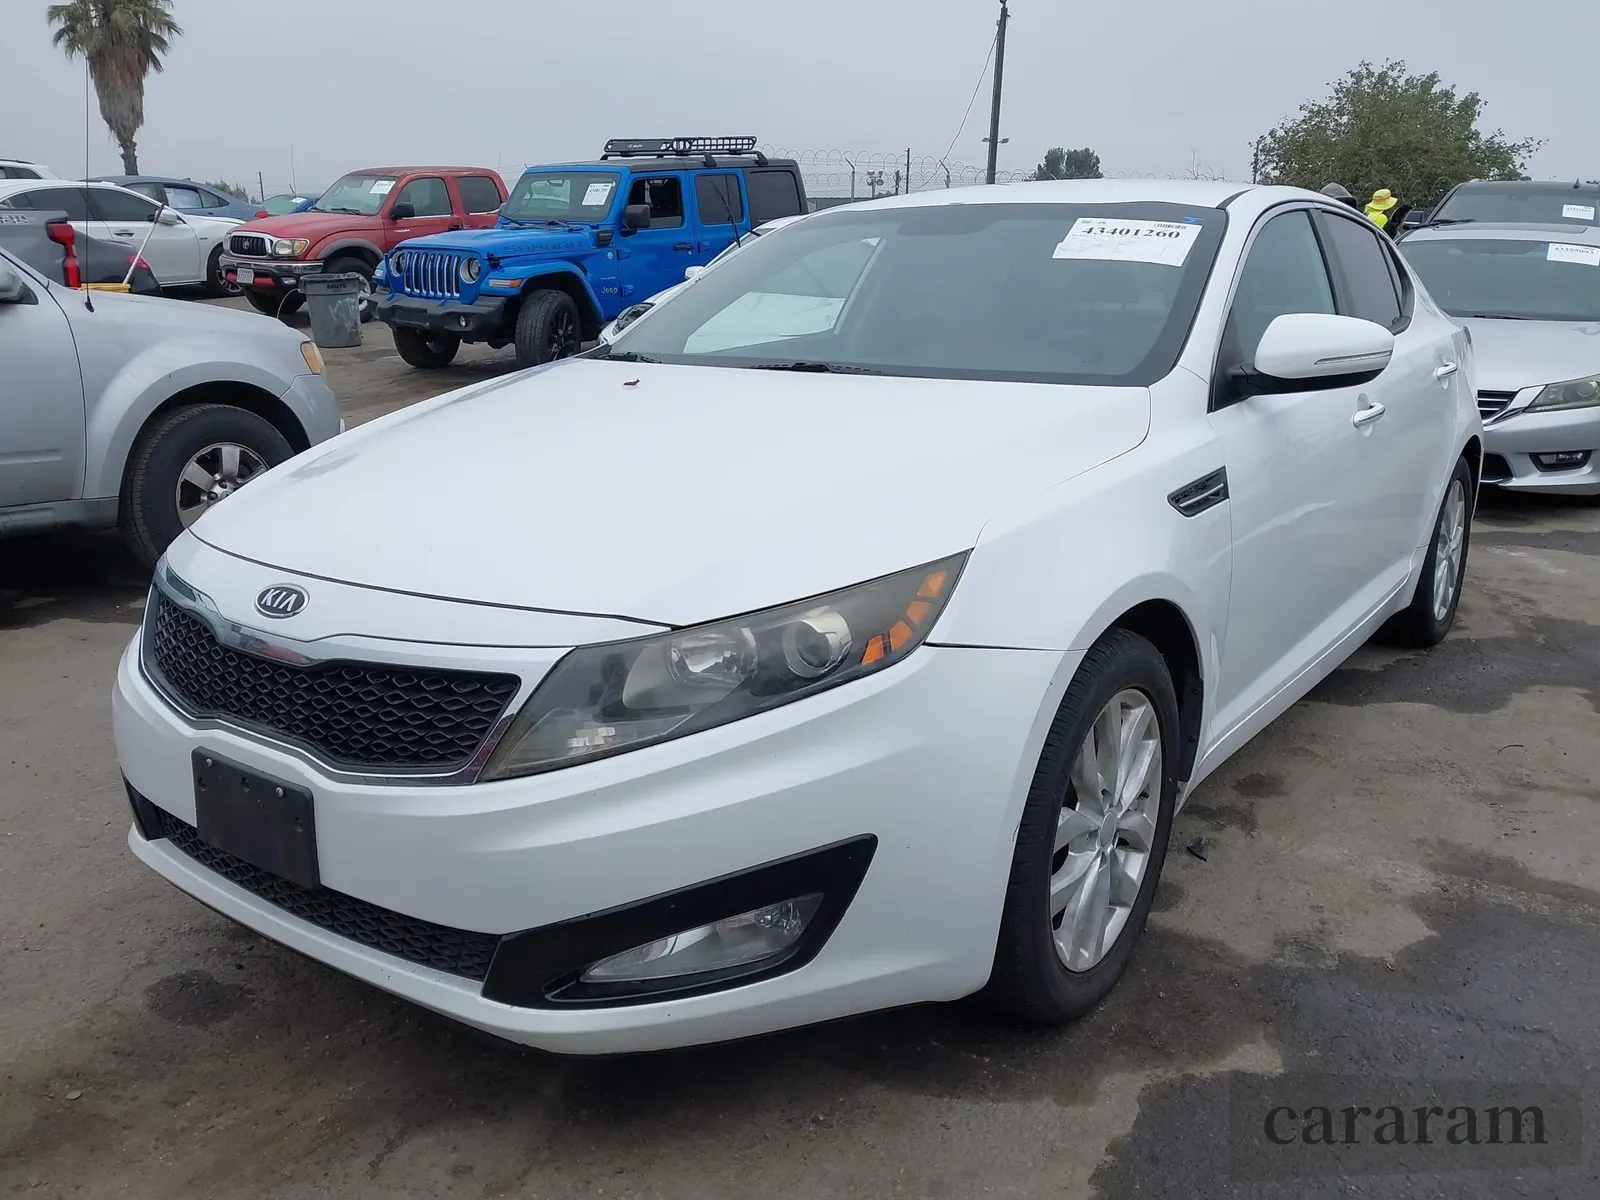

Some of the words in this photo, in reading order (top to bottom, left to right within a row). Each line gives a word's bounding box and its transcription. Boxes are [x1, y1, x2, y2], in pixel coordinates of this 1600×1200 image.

[1082, 226, 1181, 239] 43401260
[601, 286, 618, 295] Jeep
[260, 588, 298, 612] KIA
